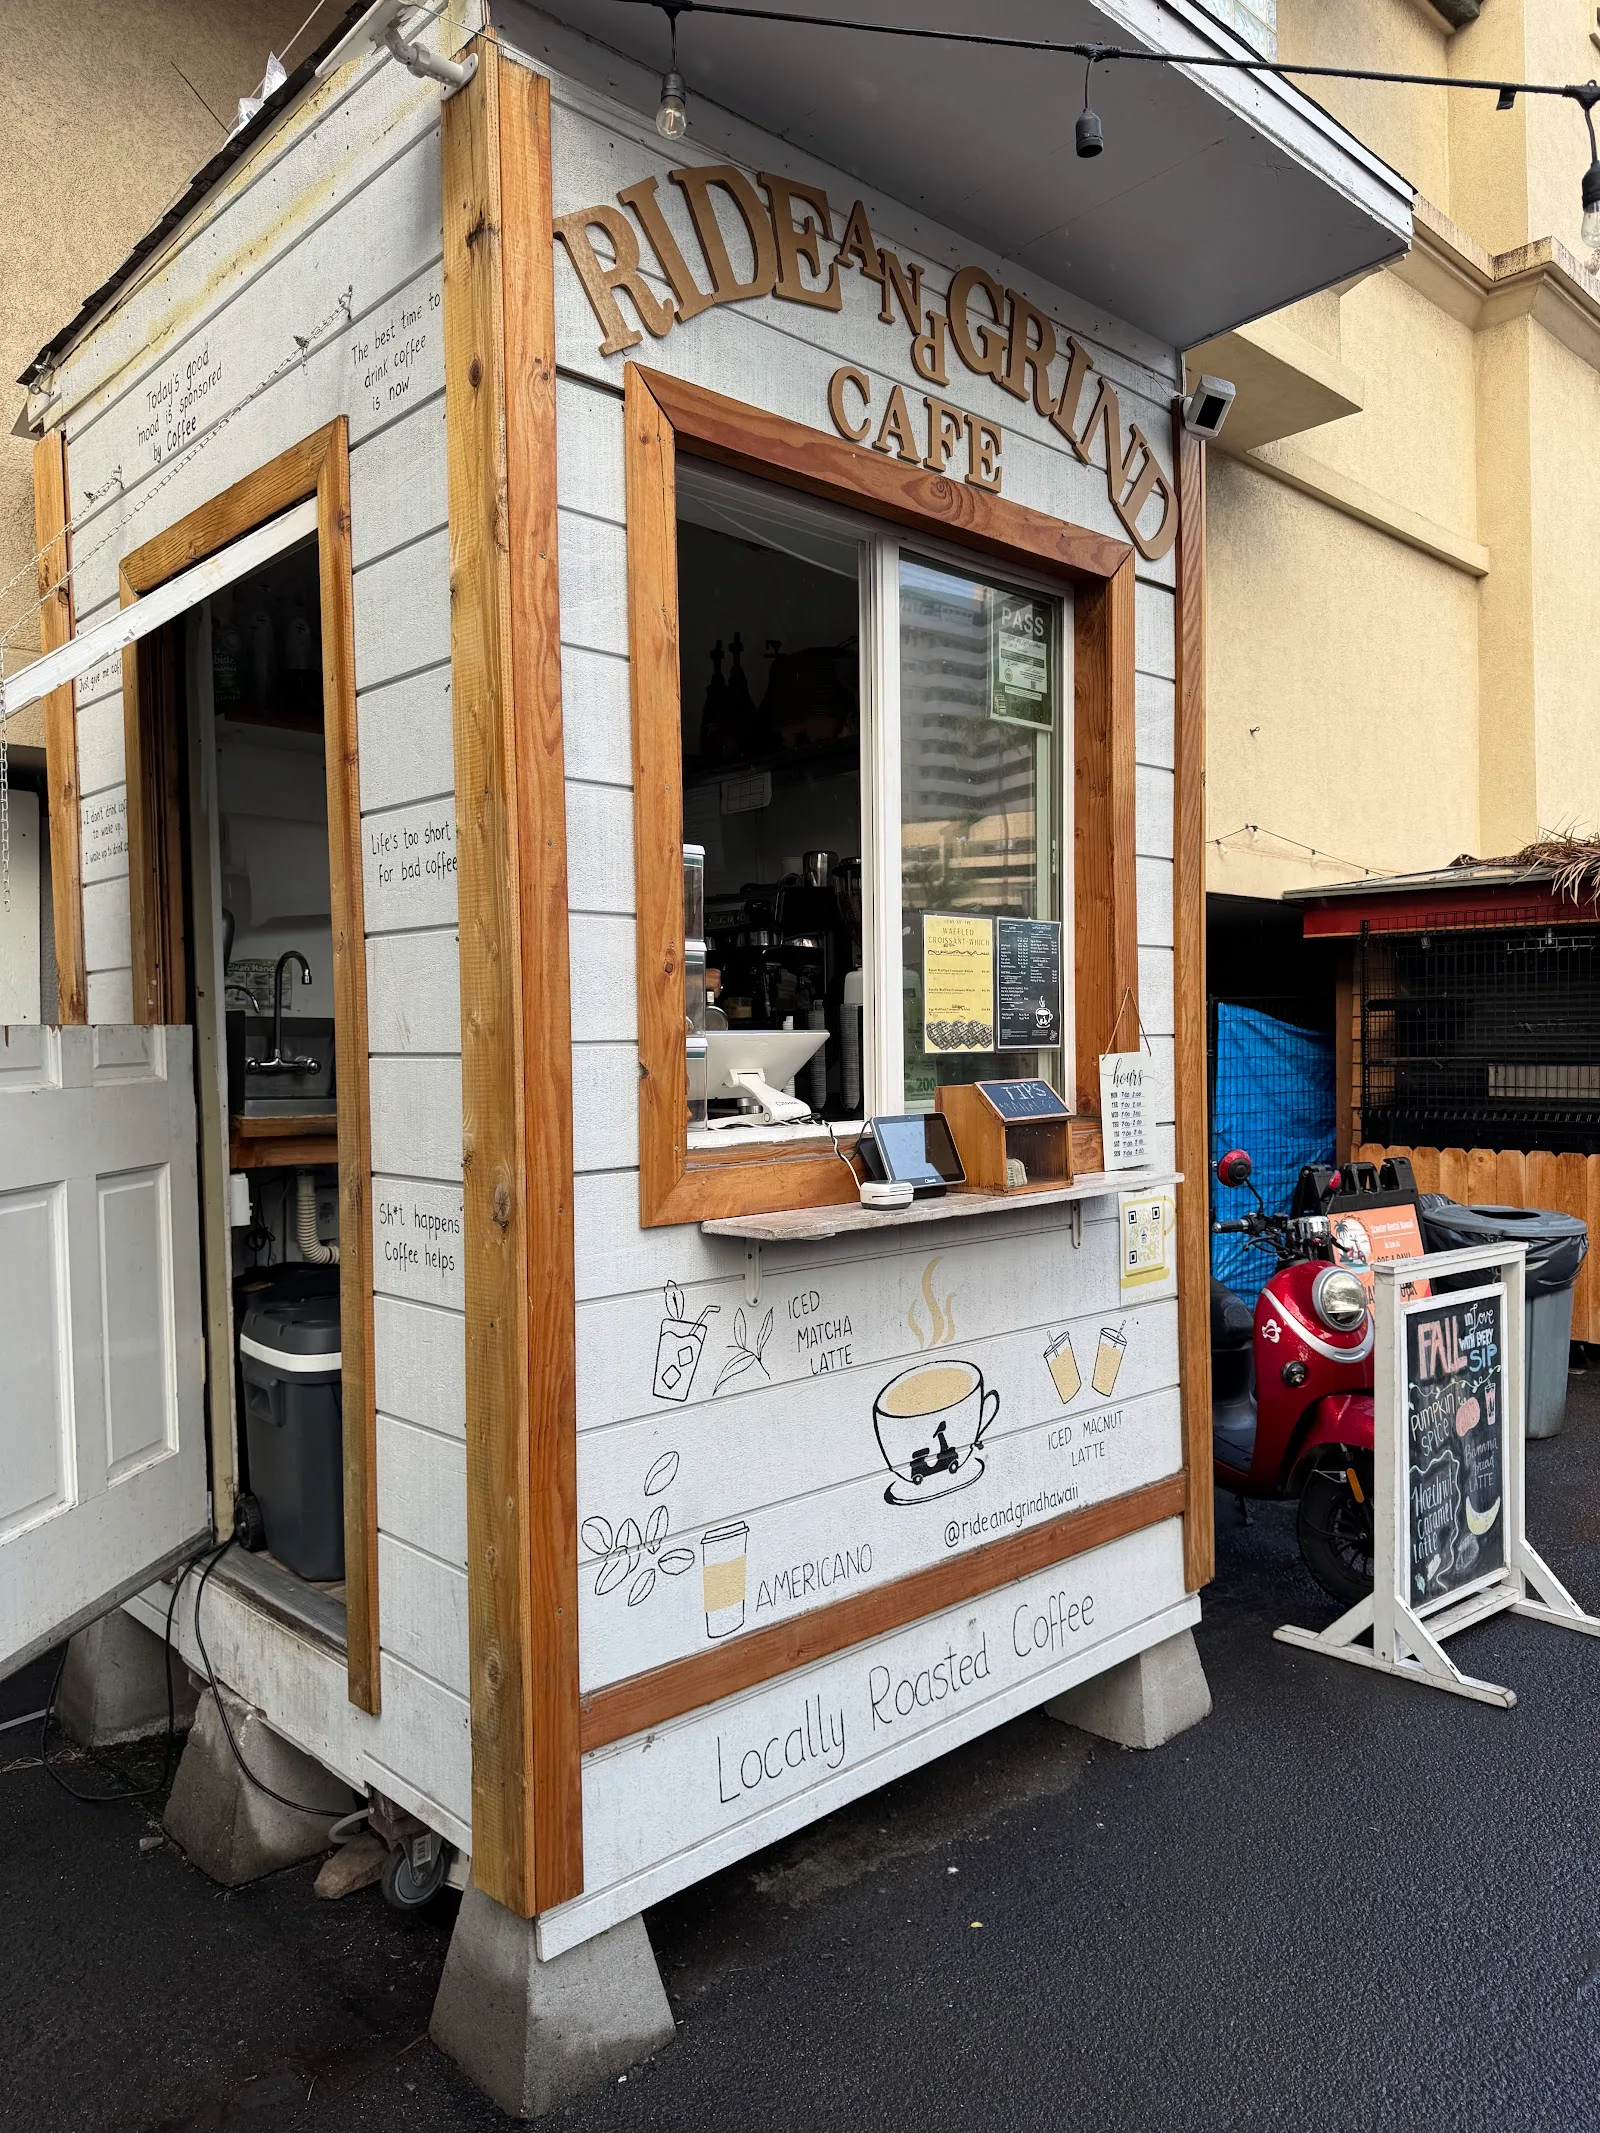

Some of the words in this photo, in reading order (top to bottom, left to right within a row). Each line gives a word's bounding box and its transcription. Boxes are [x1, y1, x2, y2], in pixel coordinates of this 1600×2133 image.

[350, 343, 370, 366] The
[373, 321, 397, 350] best
[400, 306, 423, 333] time
[428, 290, 442, 311] to
[145, 371, 182, 414] Today's
[185, 342, 211, 386] good
[363, 361, 389, 390] drink
[393, 332, 428, 371] coffee
[553, 164, 843, 357] RIDE
[946, 265, 1180, 561] GRIND
[137, 413, 161, 448] mood
[164, 403, 174, 422] is
[178, 361, 223, 414] sponsored
[371, 391, 382, 413] is
[388, 375, 411, 403] now
[151, 440, 164, 465] by
[165, 413, 198, 453] Coffee
[827, 366, 1003, 494] CAFE
[1001, 606, 1045, 637] PASS
[91, 672, 100, 692] give
[102, 668, 110, 679] me
[105, 803, 118, 818] drink
[92, 828, 99, 840] to
[101, 823, 114, 837] wake
[371, 832, 399, 857] Life's
[403, 827, 419, 850] too
[424, 820, 452, 844] short
[85, 852, 89, 865] I
[89, 850, 101, 864] wake
[113, 841, 124, 855] drink
[401, 856, 421, 881] bad
[425, 851, 458, 881] coffee
[928, 935, 990, 947] CROISSANT-WHICH
[942, 927, 974, 937] WAFFLED
[251, 963, 277, 973] Hand
[1110, 1057, 1147, 1088] hours
[414, 1203, 460, 1241] happens
[384, 1240, 419, 1272] Coffee
[424, 1243, 455, 1279] helps
[786, 1289, 821, 1320] ICED
[796, 1315, 854, 1353] MATCHA
[1417, 1315, 1468, 1380] FALL
[1458, 1334, 1477, 1351] WITH
[1476, 1327, 1495, 1348] EVERY
[809, 1344, 854, 1376] LATTE
[1469, 1343, 1498, 1373] SIP
[1047, 1425, 1073, 1451] ICED
[1082, 1409, 1124, 1437] MACNUT
[1070, 1440, 1107, 1468] LATTE
[1468, 1471, 1494, 1493] LATTE
[943, 1481, 1080, 1548] @rideandgrindhawaii
[754, 1542, 873, 1613] AMERICANO
[715, 1693, 846, 1804] Locally
[867, 1631, 992, 1732] Roasted
[1011, 1590, 1095, 1659] Coffee
